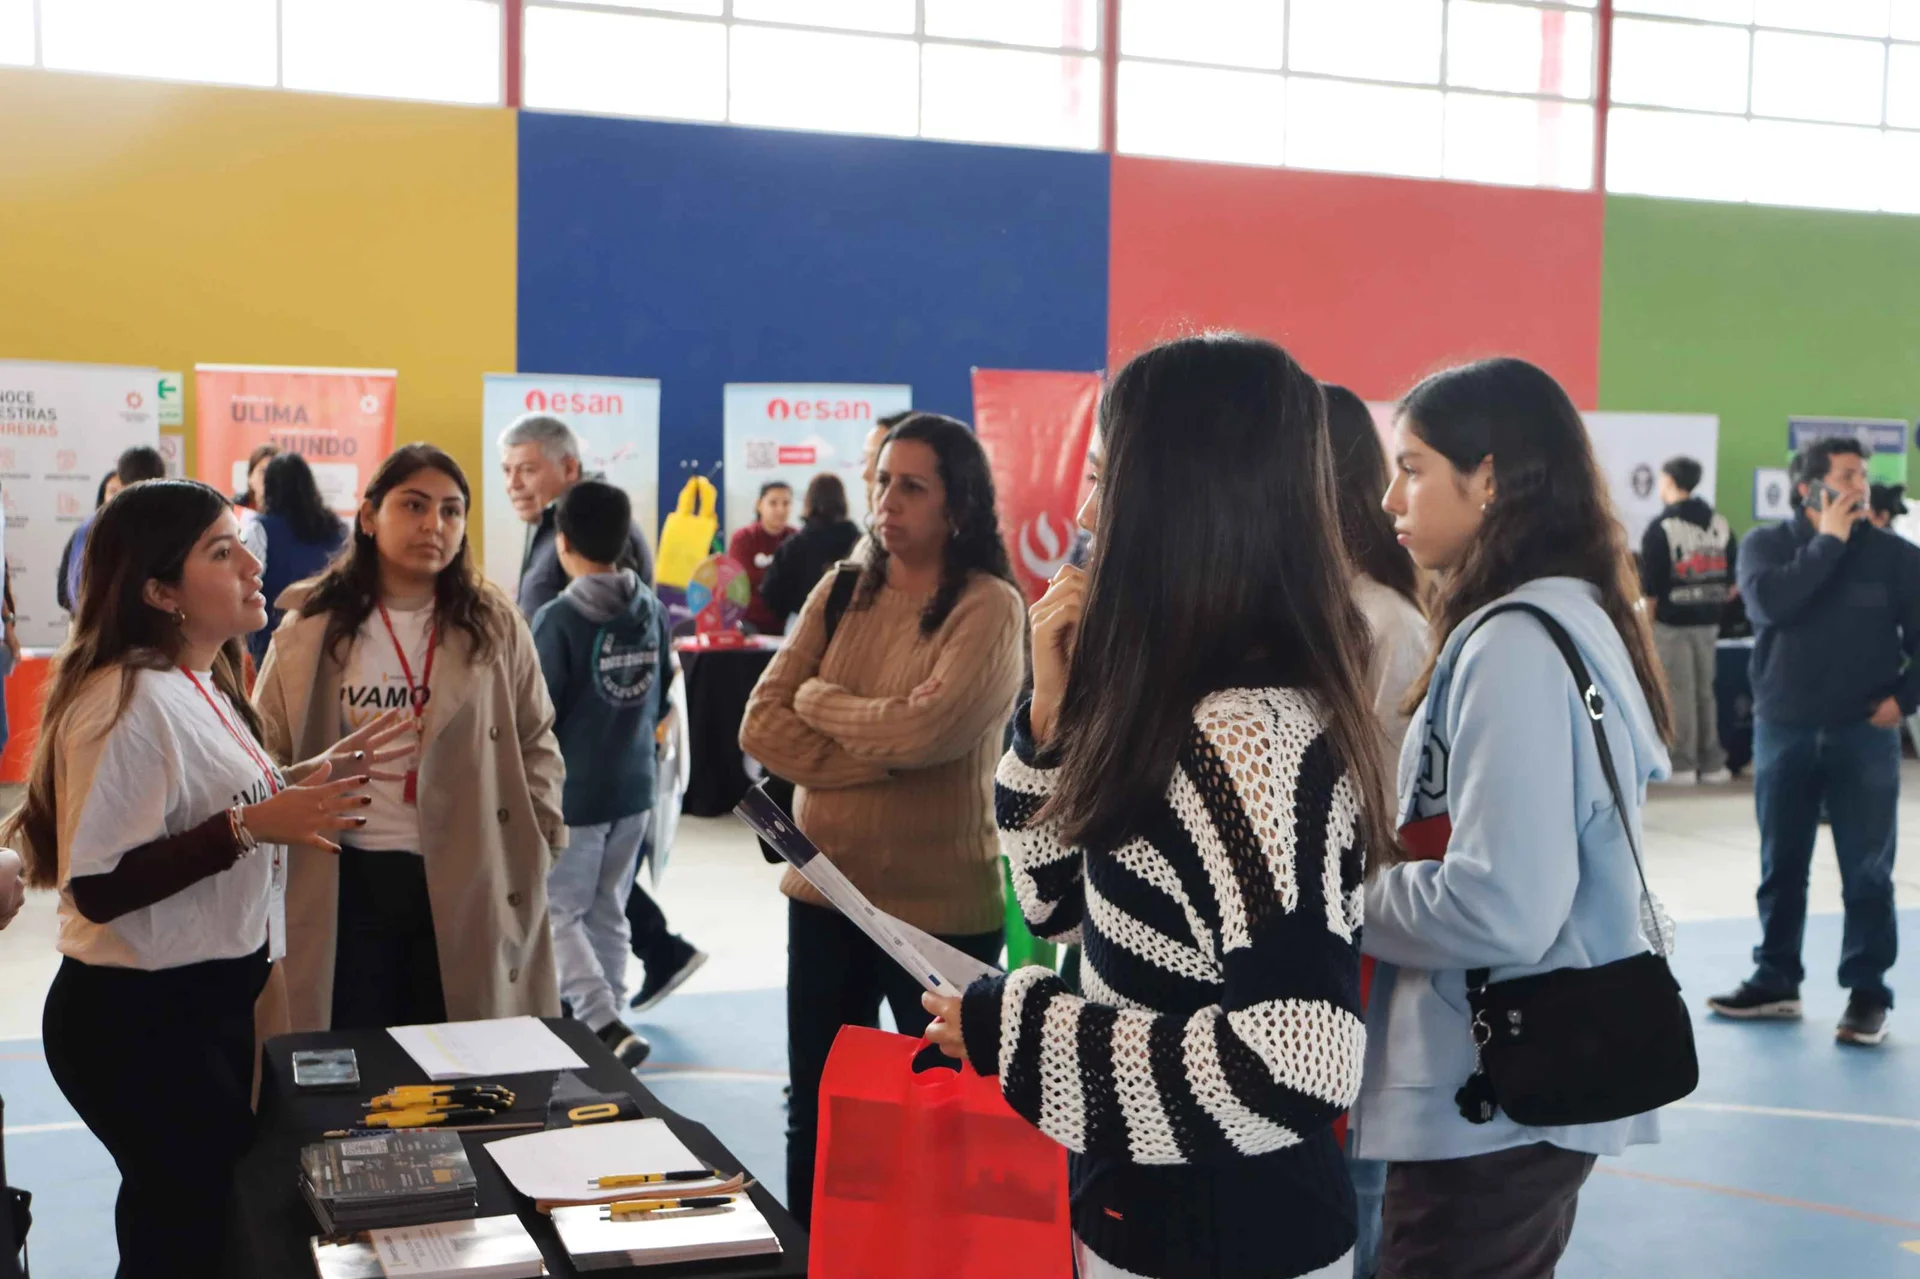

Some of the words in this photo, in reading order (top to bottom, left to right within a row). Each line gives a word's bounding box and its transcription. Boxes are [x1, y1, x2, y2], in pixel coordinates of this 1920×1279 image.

[231, 402, 308, 424] ULIMA
[551, 391, 623, 415] esan
[794, 401, 871, 420] esan
